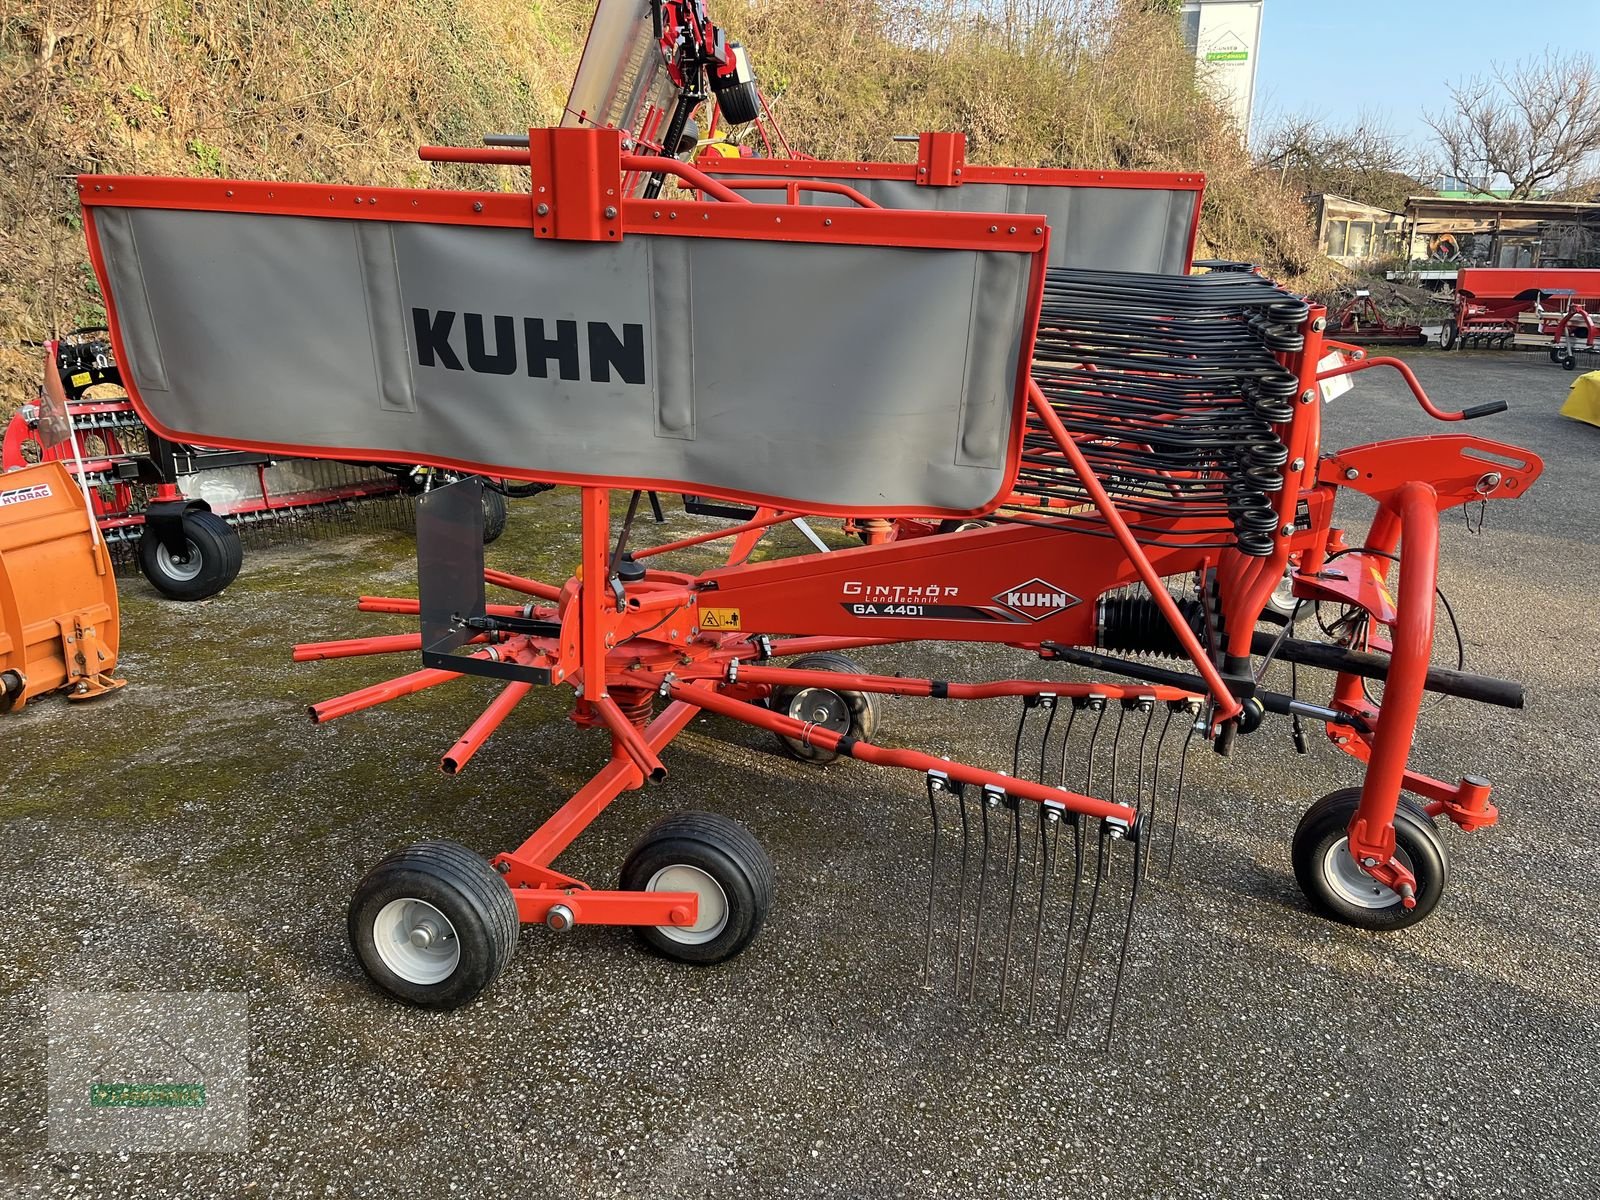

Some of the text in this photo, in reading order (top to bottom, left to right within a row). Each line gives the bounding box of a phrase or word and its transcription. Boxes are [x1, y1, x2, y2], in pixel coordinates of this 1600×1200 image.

[412, 307, 646, 385] KUHN
[2, 490, 50, 505] HYDRAC
[1007, 592, 1066, 607] KUHN
[853, 604, 923, 615] GA 4401
